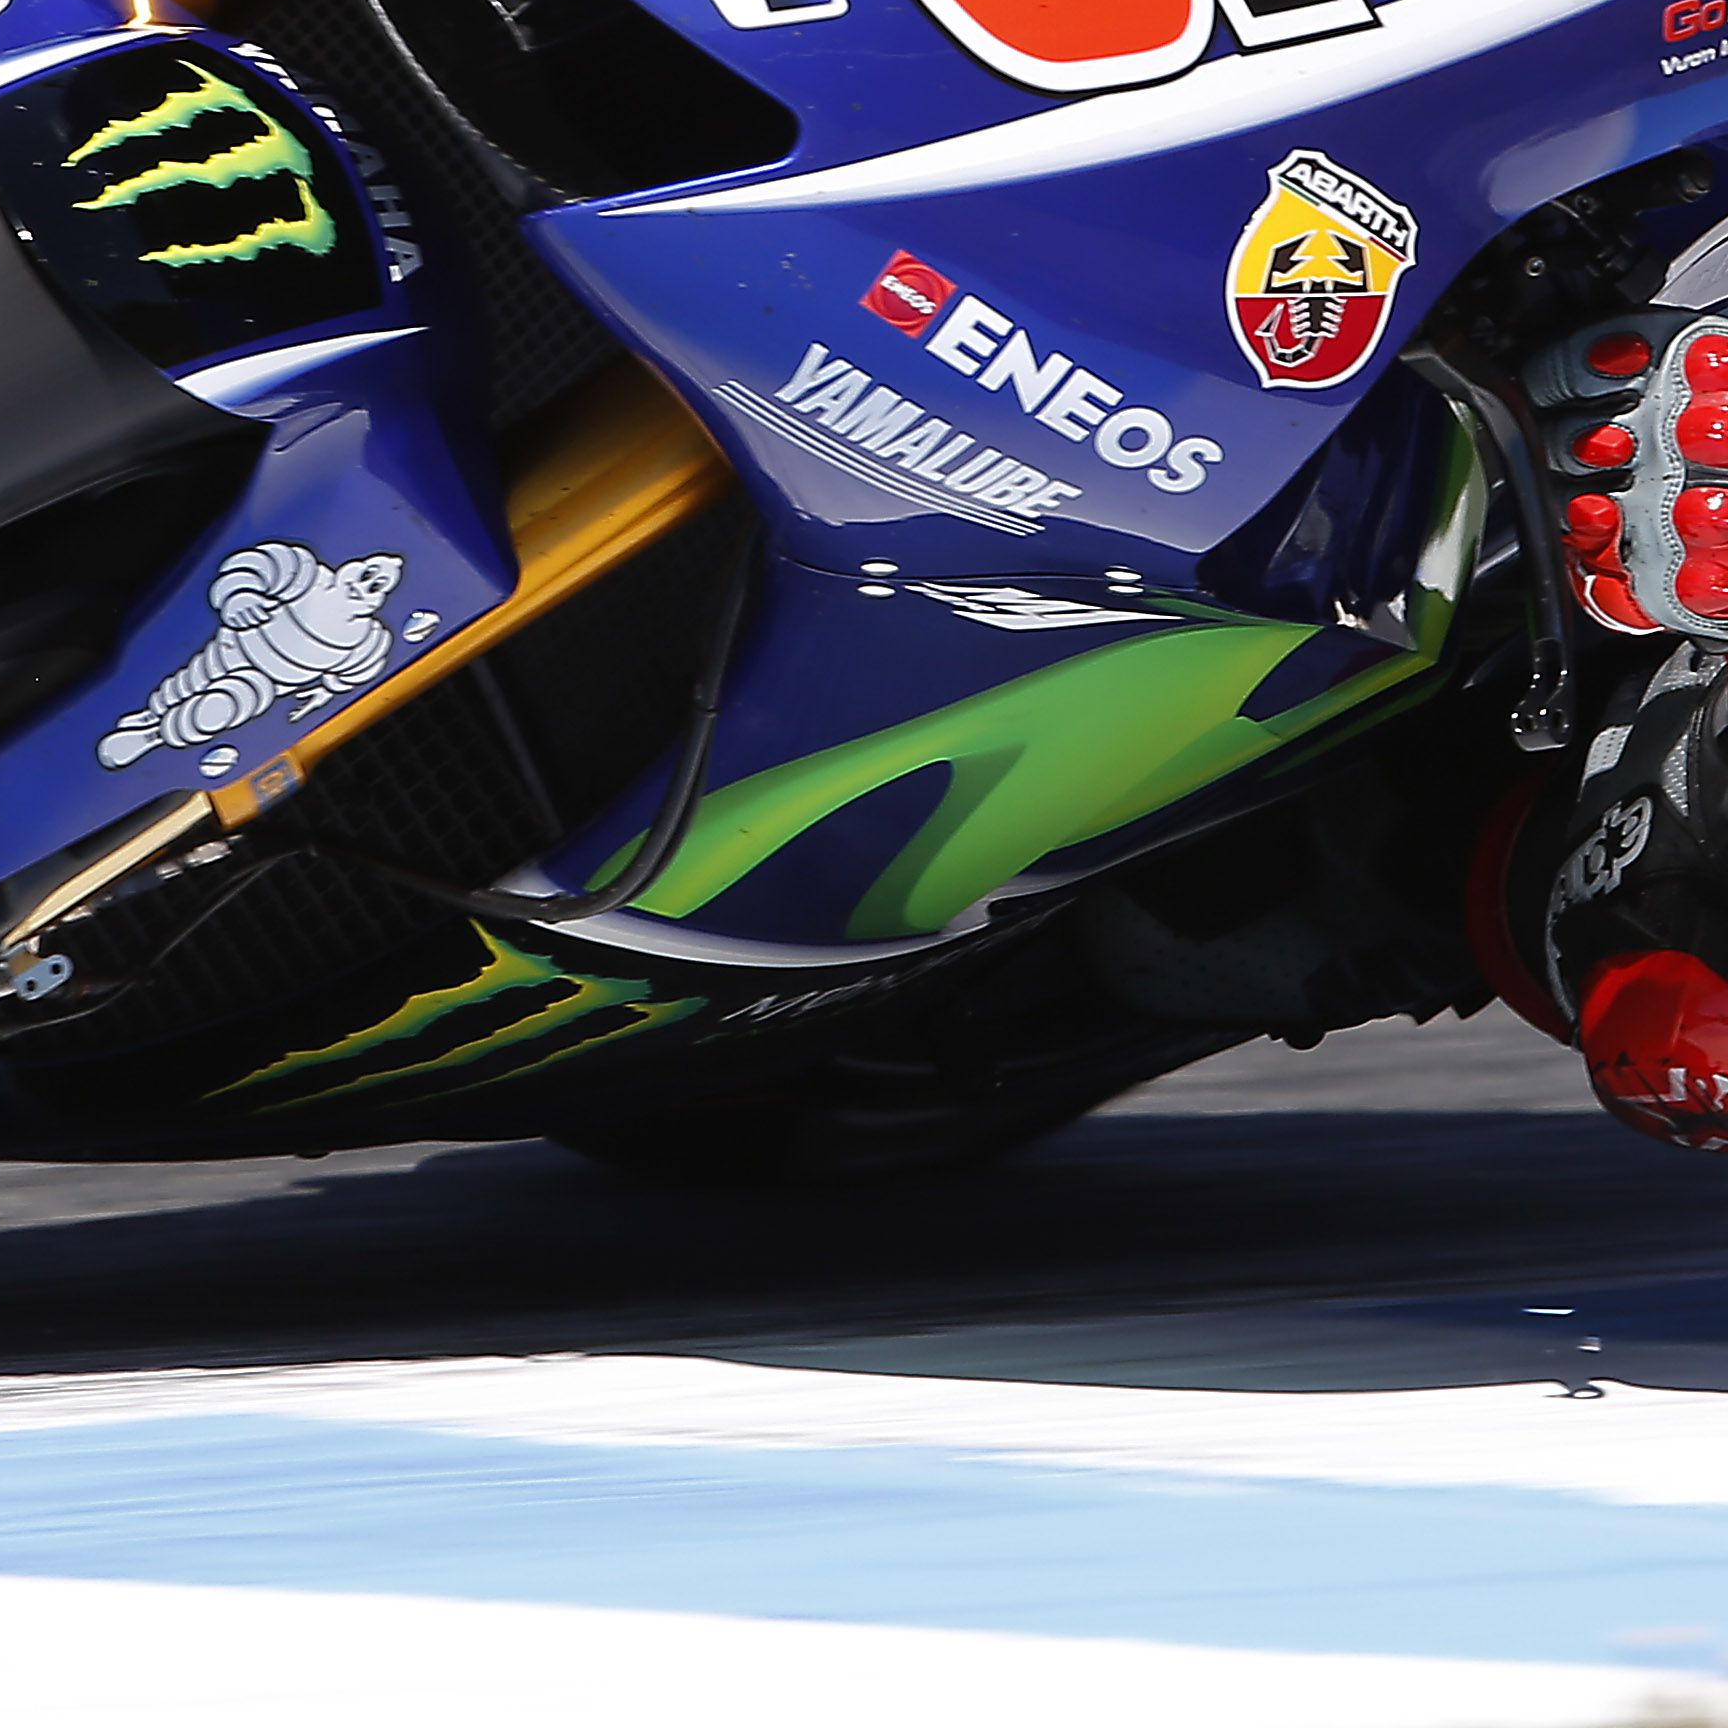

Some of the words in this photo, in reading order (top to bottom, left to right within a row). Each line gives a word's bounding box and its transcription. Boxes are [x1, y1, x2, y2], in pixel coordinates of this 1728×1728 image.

[1284, 163, 1410, 248] ABARTH
[773, 341, 1083, 519] YAMALUBE
[924, 295, 1226, 495] ENEOS
